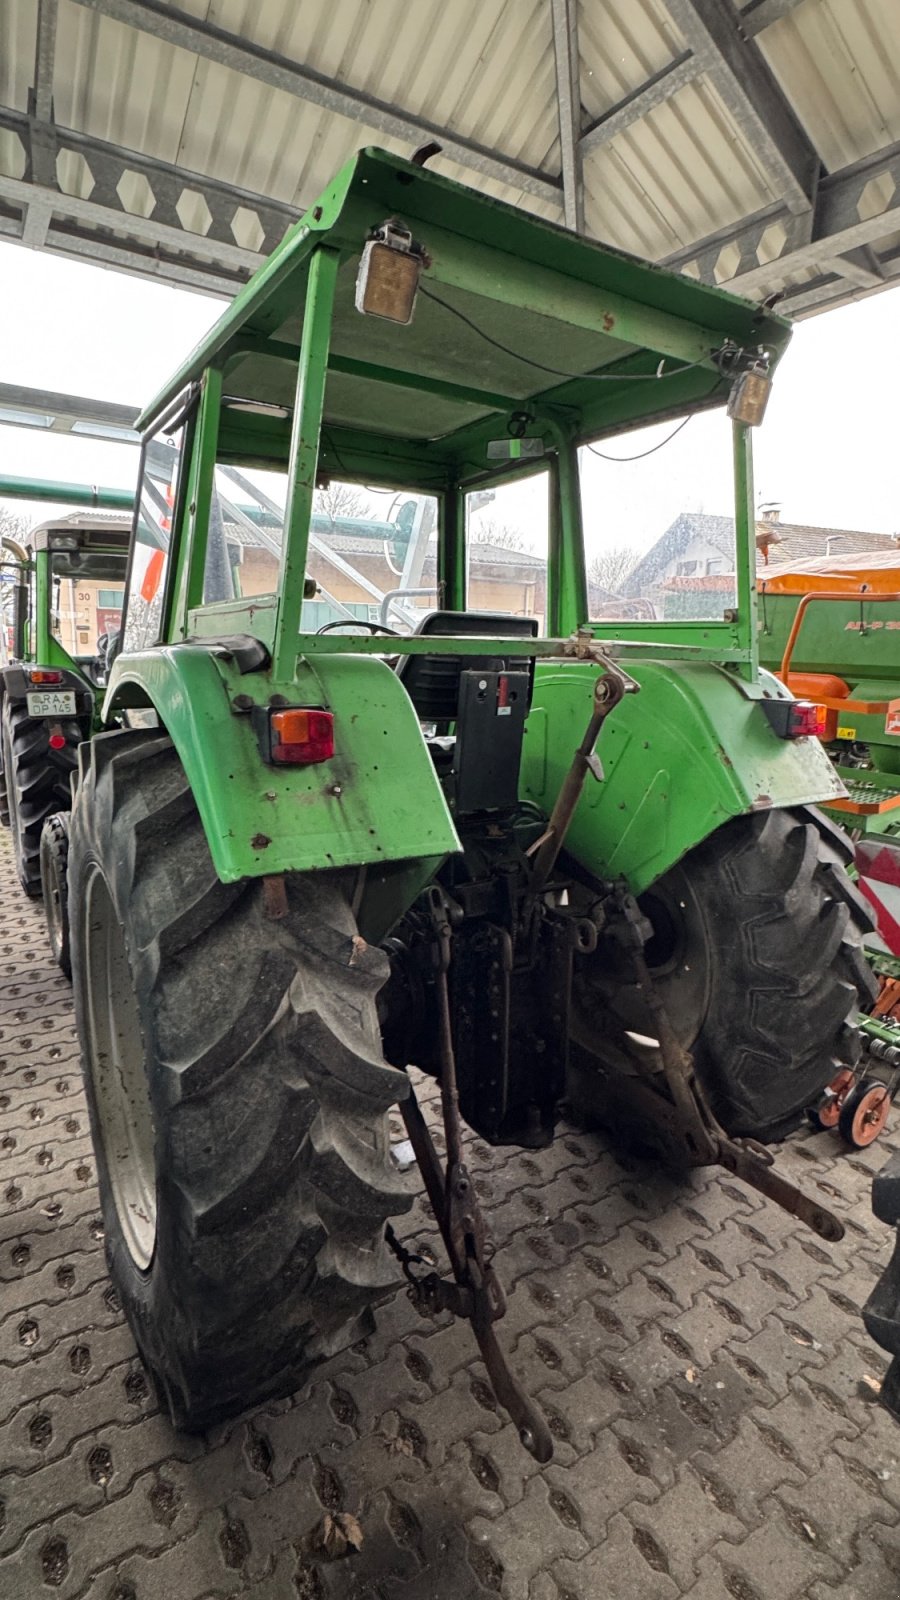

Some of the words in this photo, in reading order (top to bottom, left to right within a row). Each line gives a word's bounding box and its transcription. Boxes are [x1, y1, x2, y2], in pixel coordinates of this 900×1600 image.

[78, 592, 91, 601] 30
[43, 694, 60, 704] RA
[53, 703, 72, 713] 145
